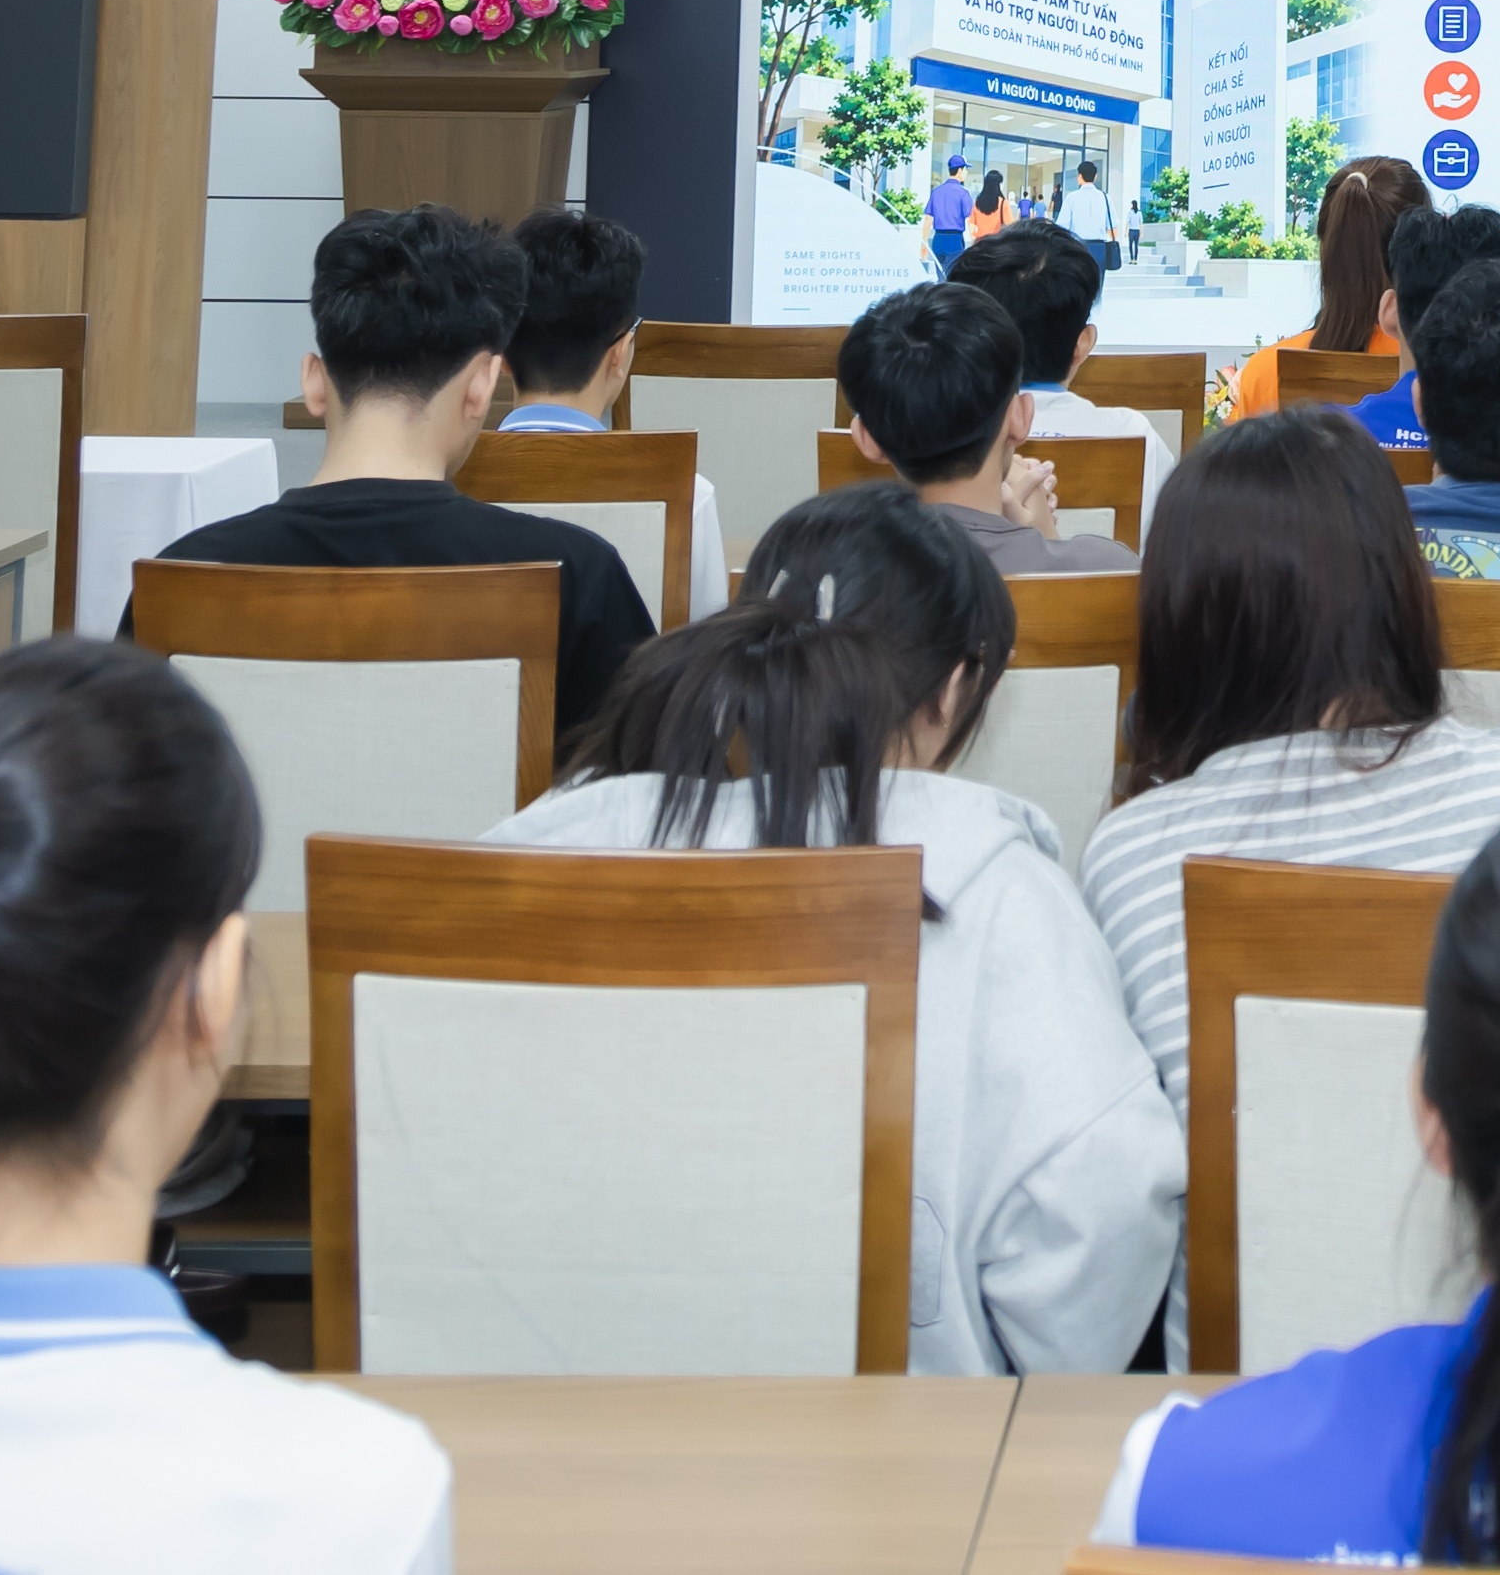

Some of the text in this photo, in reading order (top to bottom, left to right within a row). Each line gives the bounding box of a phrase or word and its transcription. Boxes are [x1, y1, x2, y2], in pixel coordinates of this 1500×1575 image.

[1074, 0, 1091, 14] TƯ
[1093, 4, 1116, 23] VẤN
[1009, 4, 1034, 25] TRỢ
[1038, 11, 1078, 33] NGƯỜI
[1082, 22, 1106, 40] LAO
[1109, 29, 1144, 50] ĐỘNG
[958, 19, 990, 36] CÔNG
[993, 24, 1023, 43] ĐOÀN
[1026, 34, 1060, 53] THÀNH
[1063, 43, 1083, 58] PHỐ
[1101, 51, 1117, 66] CHÍ
[1119, 57, 1143, 72] MINH
[1209, 42, 1249, 71] KẾT NỐI
[987, 78, 1096, 112] VÌ NGƯỜI LAO ĐỘNG
[1204, 70, 1244, 97] CHIA SẺ
[1236, 94, 1266, 114] HÀNH
[1204, 124, 1251, 147] VÌ NGƯỜI
[1203, 152, 1255, 173] LAO ĐỘNG
[784, 251, 861, 260] SAME RIGHTS
[784, 268, 909, 277] MORE OPPORTUNITIES
[783, 284, 887, 294] BRIGHTER FUTURE
